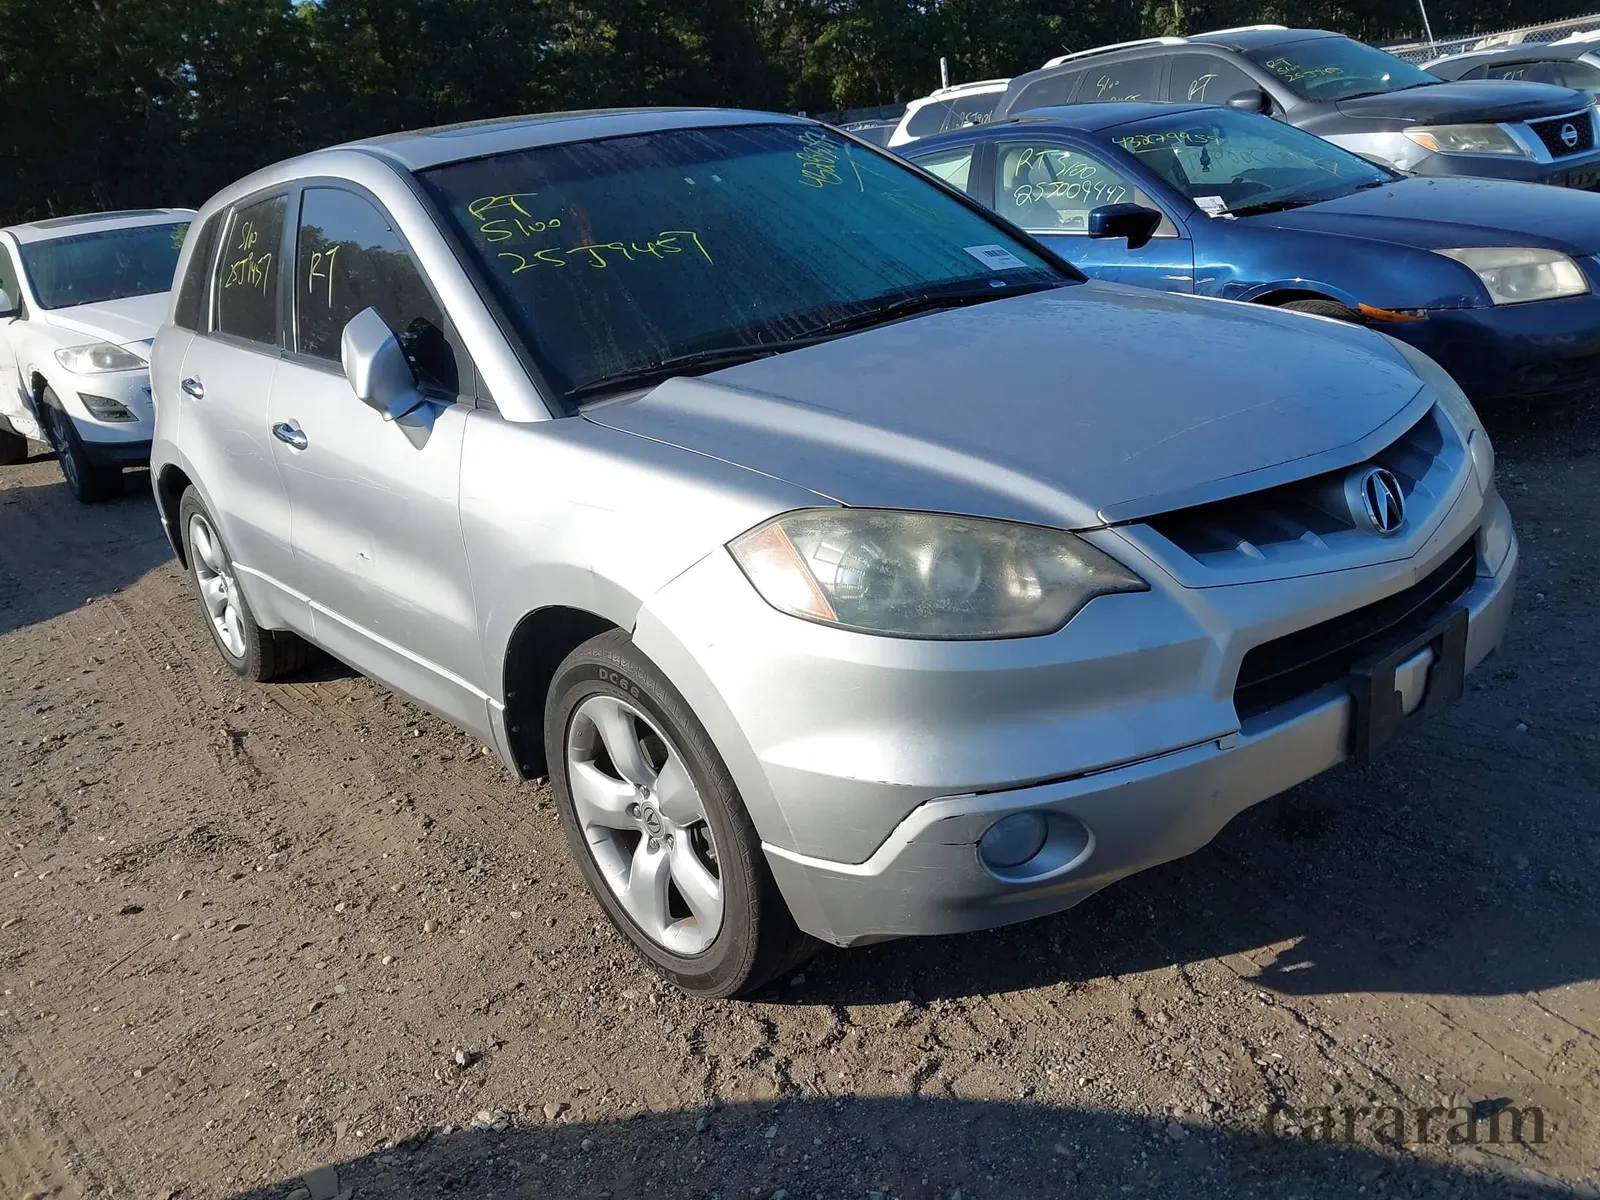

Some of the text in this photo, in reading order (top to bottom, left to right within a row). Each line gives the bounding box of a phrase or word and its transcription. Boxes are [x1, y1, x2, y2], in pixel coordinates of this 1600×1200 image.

[1188, 74, 1219, 102] RT
[1015, 148, 1049, 177] RT
[468, 193, 538, 220] RT
[308, 246, 340, 308] RT
[598, 667, 640, 699] DC66
